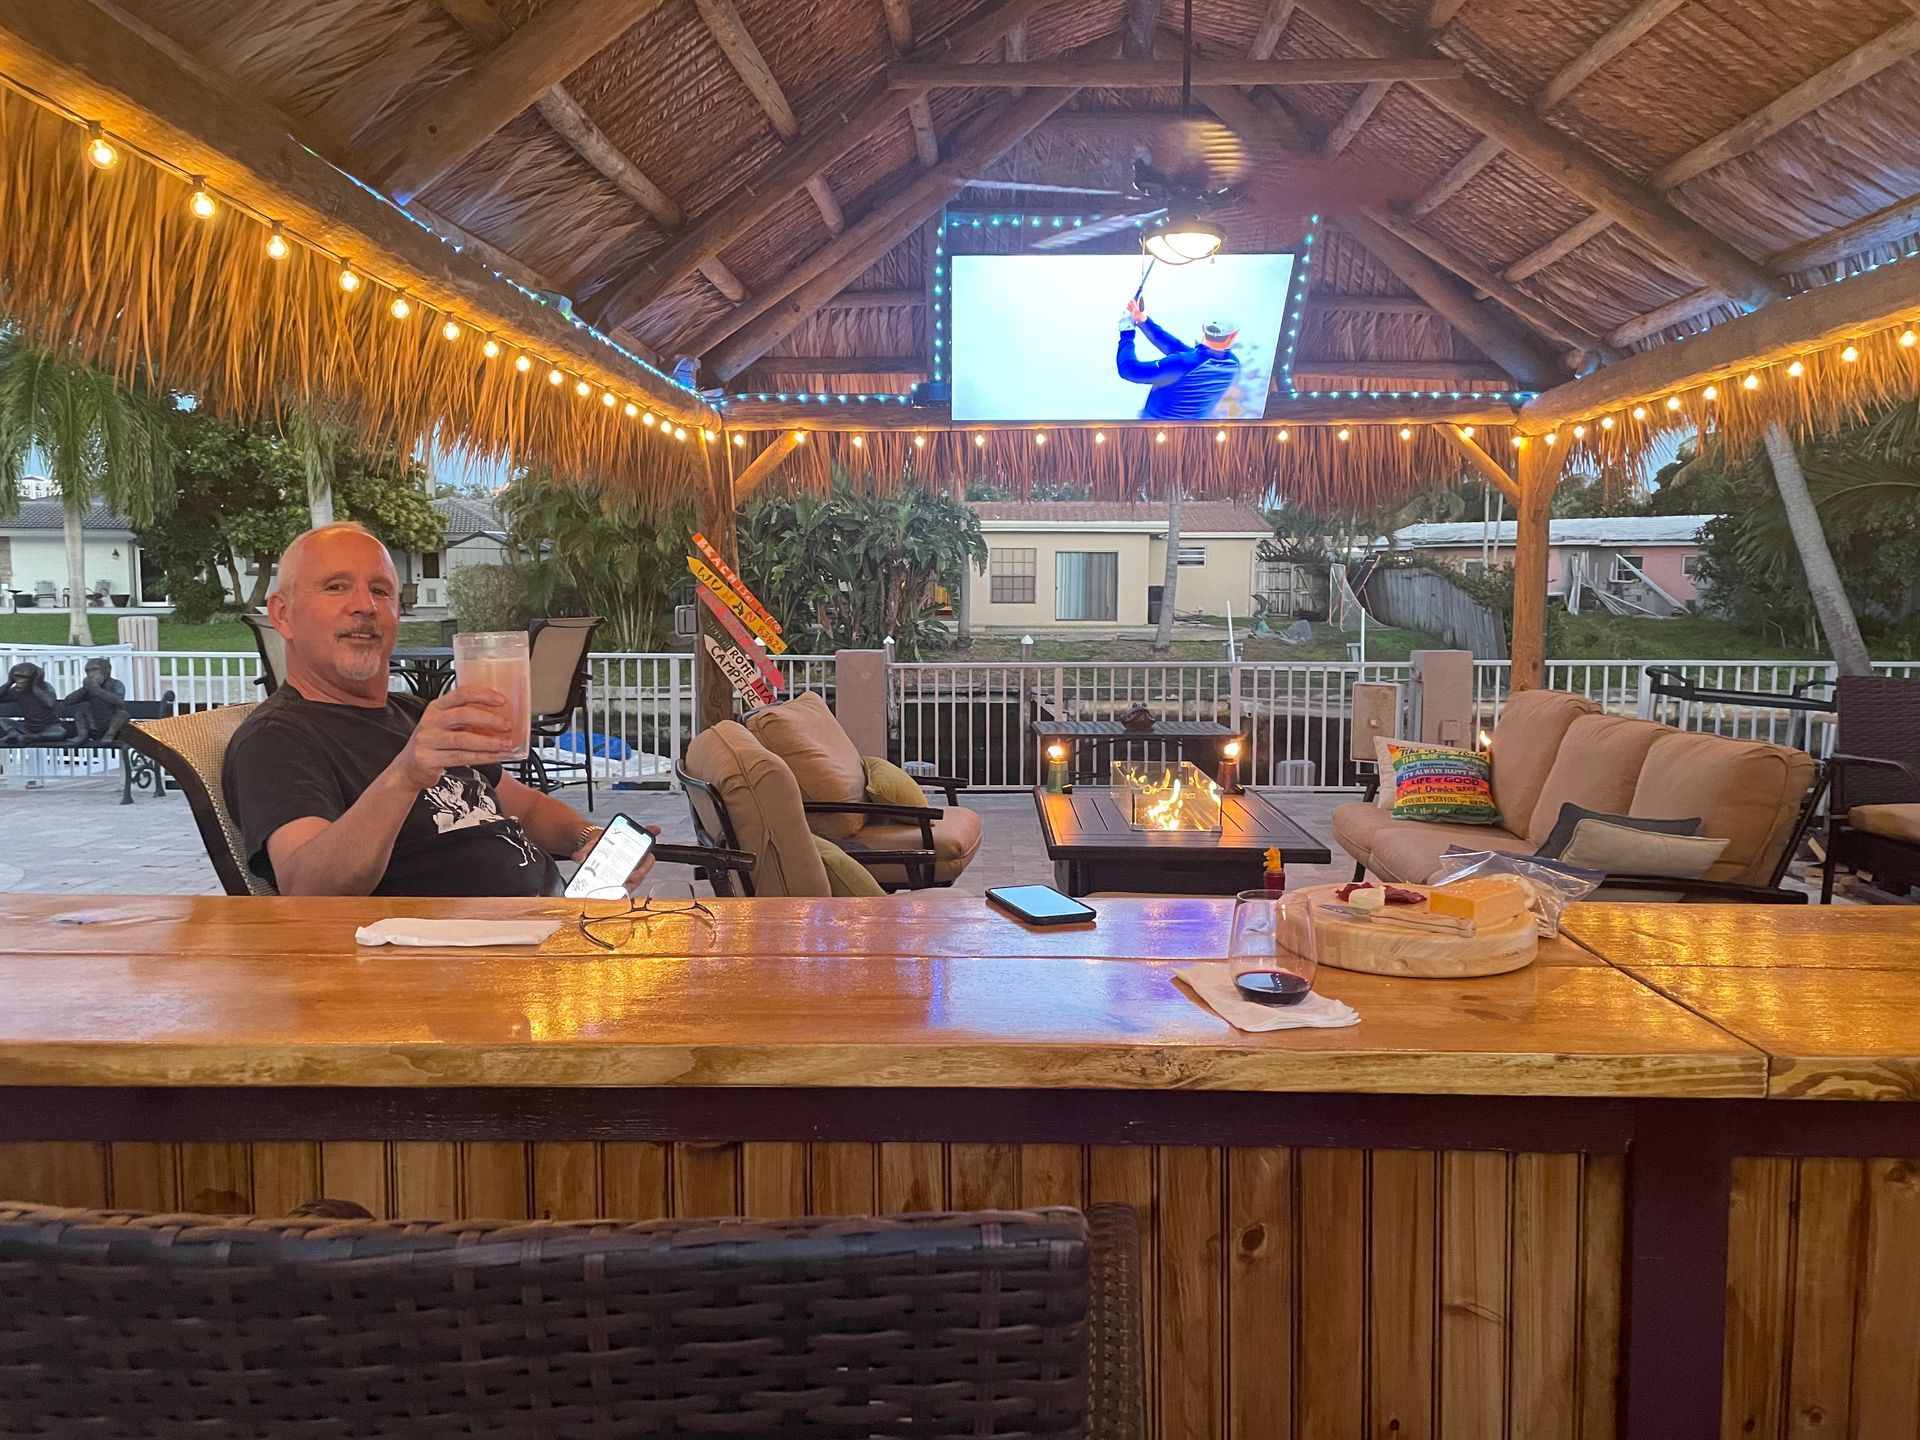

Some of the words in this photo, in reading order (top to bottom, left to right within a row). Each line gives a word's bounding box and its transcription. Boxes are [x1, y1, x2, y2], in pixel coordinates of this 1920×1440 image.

[698, 537, 738, 585] BEACH
[697, 566, 756, 623] WUHAN
[757, 625, 779, 650] 8382
[711, 645, 761, 708] CAMPFIRE
[729, 649, 755, 679] ROME
[1411, 776, 1432, 785] LIFE
[1444, 776, 1480, 786] GOOD
[1425, 785, 1453, 793] Drinks
